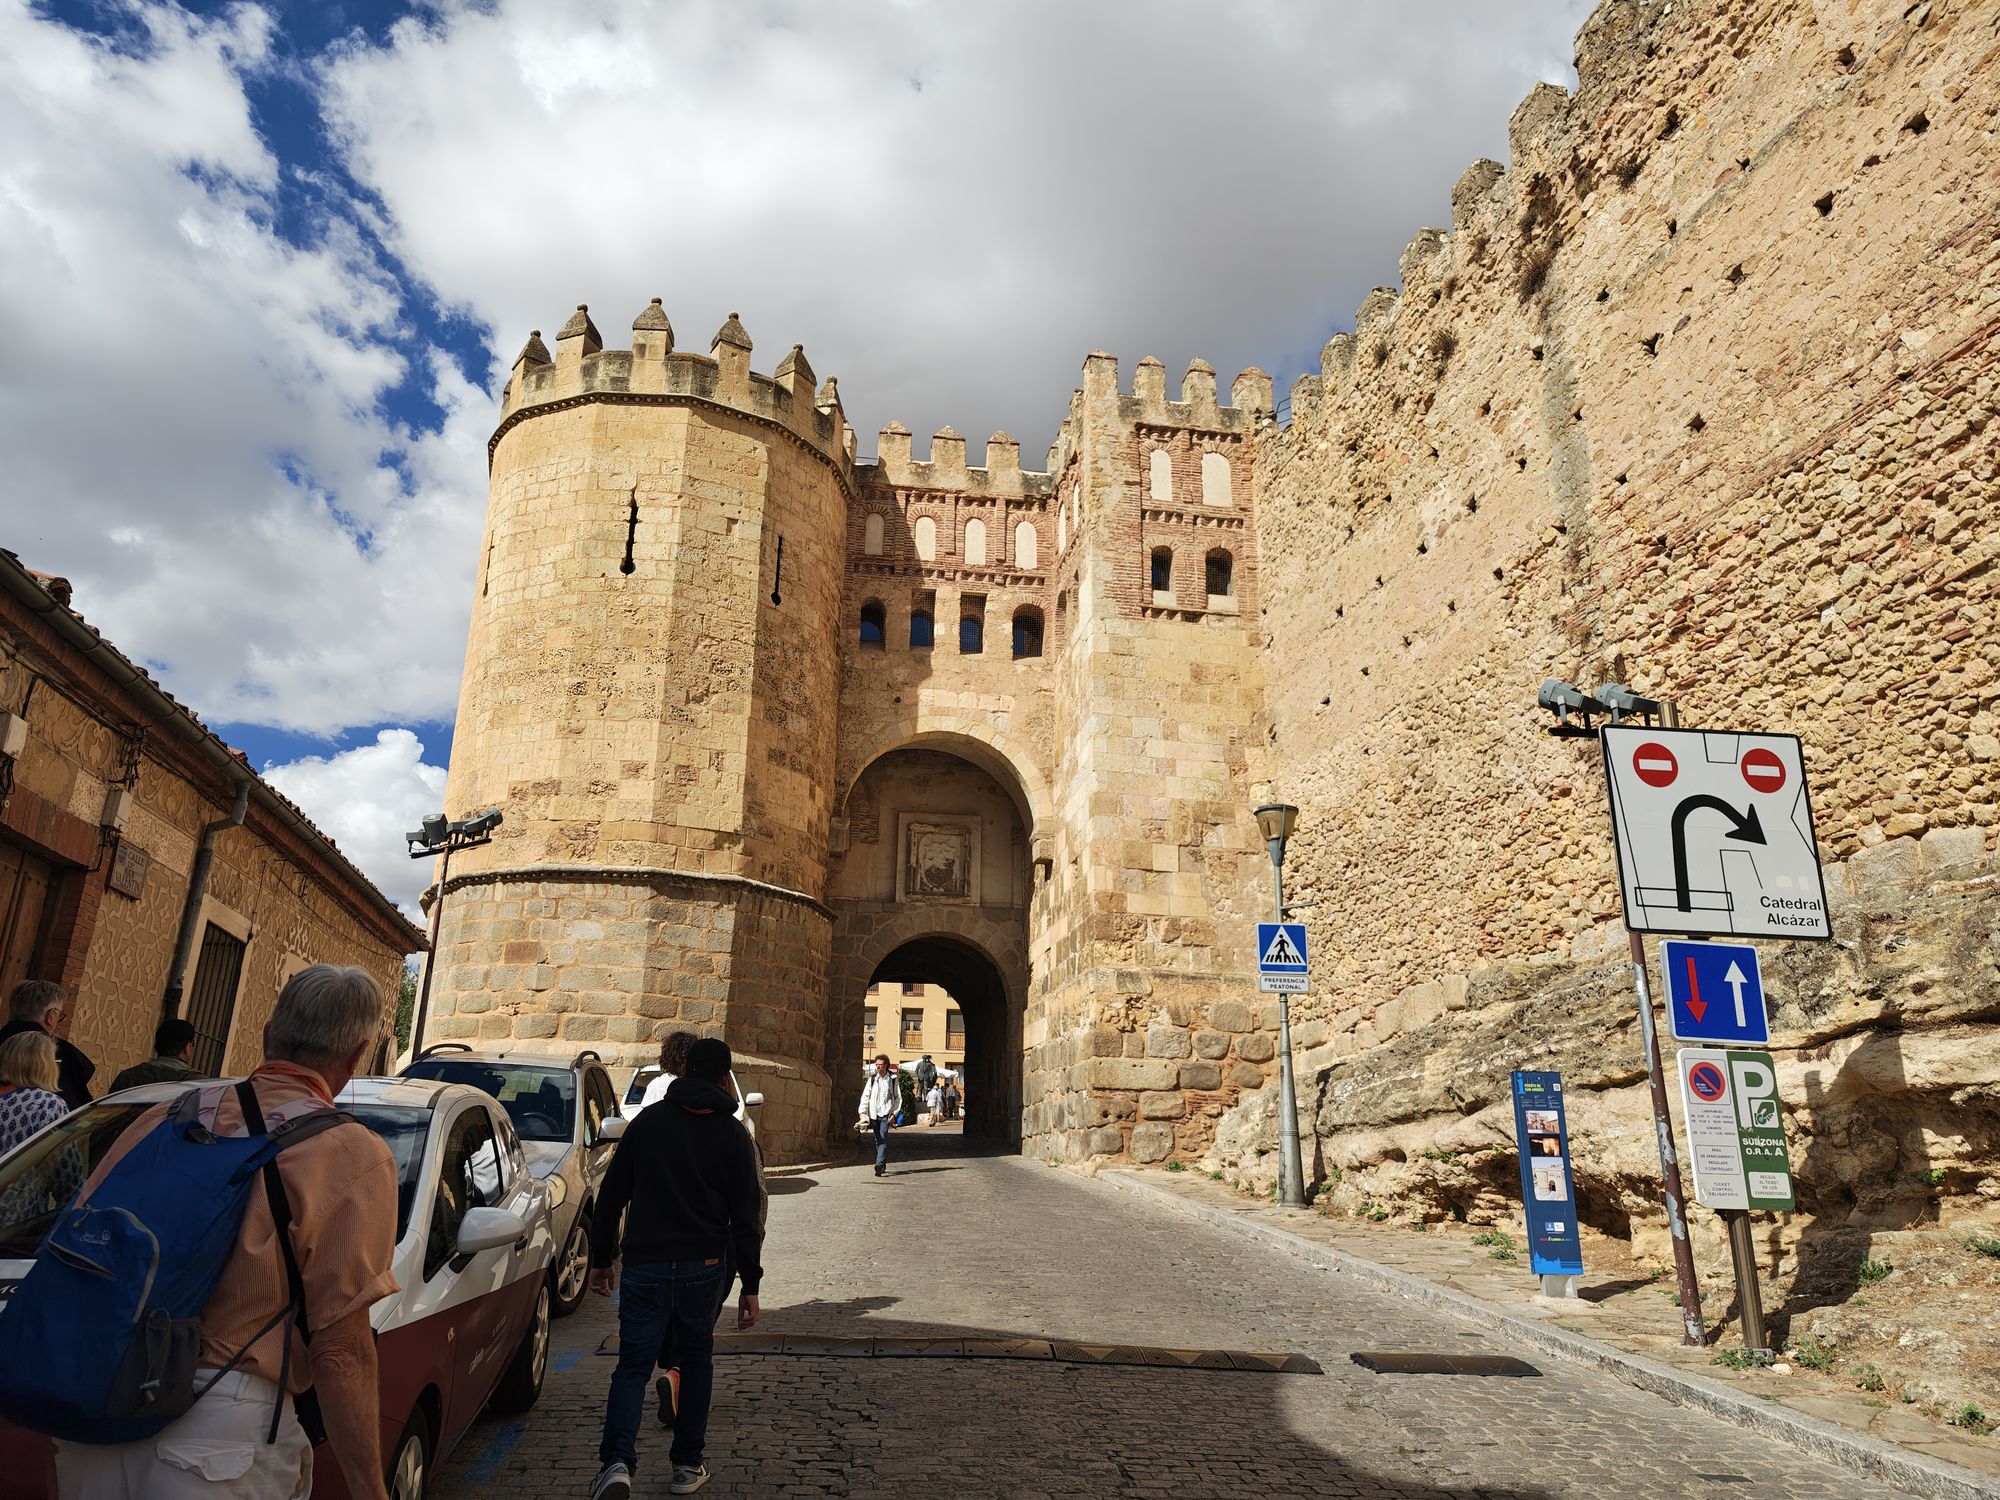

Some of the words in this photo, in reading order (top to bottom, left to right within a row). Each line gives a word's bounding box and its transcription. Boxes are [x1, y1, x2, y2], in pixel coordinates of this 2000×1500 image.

[128, 851, 145, 867] CALLE
[1760, 896, 1821, 911] Catedral
[1767, 913, 1820, 927] Alcázar
[1732, 1060, 1774, 1128] P
[1742, 1138, 1785, 1146] SUBZONA
[1745, 1147, 1773, 1156] O.R.A.
[1774, 1147, 1785, 1157] A
